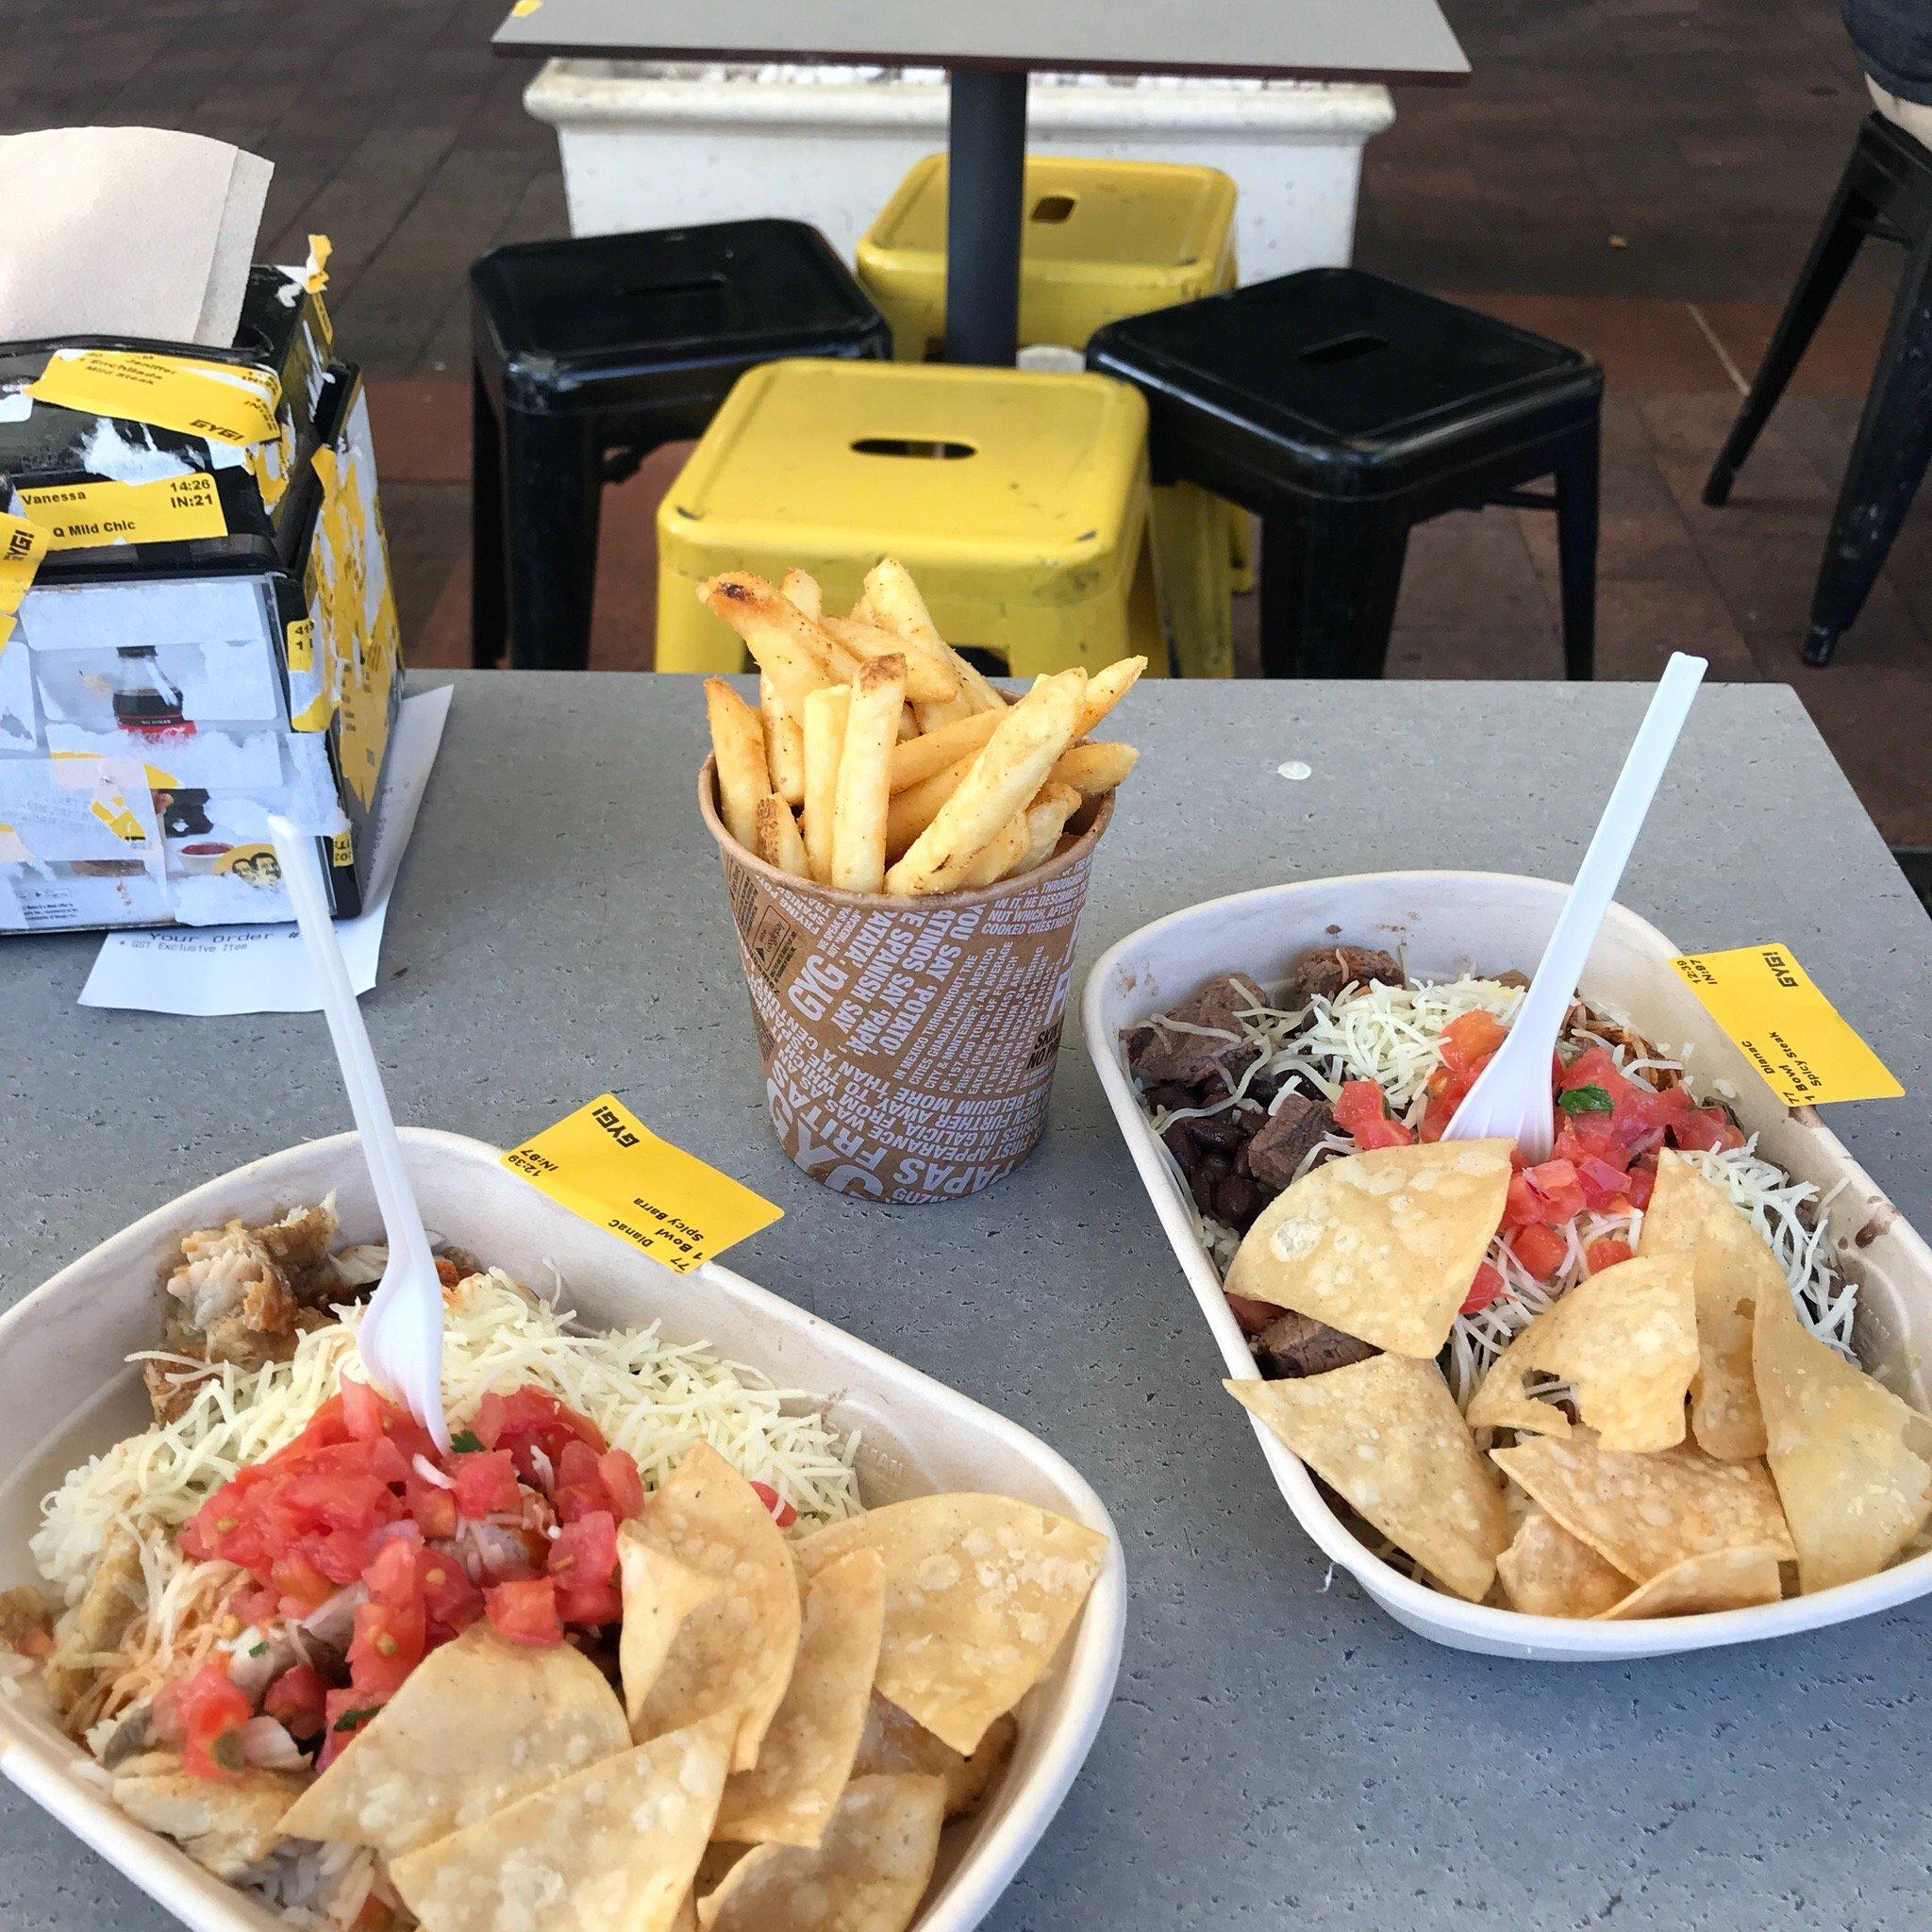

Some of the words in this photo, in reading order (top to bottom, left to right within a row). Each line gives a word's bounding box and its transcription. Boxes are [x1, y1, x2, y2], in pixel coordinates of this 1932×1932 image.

[190, 419, 245, 441] GYG!
[22, 490, 86, 506] Vanessa
[170, 479, 210, 493] 14:26
[171, 493, 213, 509] IN:21
[53, 528, 65, 539] Q
[995, 898, 1009, 908] IN
[1023, 896, 1038, 908] HE
[779, 897, 820, 935] FRYING
[949, 903, 987, 941] YOU
[988, 909, 1014, 922] NUT
[150, 932, 200, 943] Your
[824, 917, 844, 941] SPEAK
[902, 909, 957, 973] ATINOS
[981, 923, 1026, 936] COOKED
[158, 942, 217, 953] Exclusive
[851, 928, 914, 1003] SPANISH
[925, 944, 961, 982] SAY
[1676, 960, 1702, 984] 12:39
[1762, 951, 1798, 988] GYG!
[789, 954, 849, 1022] GYG
[879, 973, 914, 1008] SAY
[831, 1000, 863, 1034] SAY
[892, 1069, 907, 1080] IN
[900, 1037, 929, 1069] MEXICO
[923, 975, 965, 1035] THROUGHOUT
[959, 955, 978, 974] THE
[909, 1058, 933, 1085] CITIES
[969, 947, 996, 987] MEXICO
[924, 1070, 942, 1089] CITY
[938, 1060, 948, 1070] &
[976, 989, 990, 1002] AN
[985, 941, 1013, 986] AVERAGE
[939, 1081, 953, 1091] OF
[970, 1014, 991, 1042] TONS
[985, 999, 996, 1011] OF
[993, 956, 1019, 995] FRENCH
[968, 1065, 990, 1094] EATEN
[985, 1044, 1000, 1063] PER
[1016, 944, 1045, 999] SPENDING
[983, 1083, 994, 1094] 41
[991, 1042, 1013, 1080] BILLION
[1008, 992, 1034, 1039] MEXICAN
[1030, 956, 1049, 990] PESOS
[1021, 1008, 1039, 1042] PAPAS
[1034, 1015, 1042, 1028] OF
[954, 1067, 975, 1093] FRIES
[971, 1031, 995, 1065] (PAPAS
[990, 991, 1016, 1028] FRITAS)
[1010, 966, 1024, 988] ARE
[1026, 1030, 1038, 1048] LOT
[823, 1048, 838, 1063] A
[1012, 1042, 1023, 1056] ON
[1023, 1049, 1030, 1058] A
[1769, 1031, 1798, 1058] Steak
[784, 1044, 836, 1097] WHICH
[811, 1054, 841, 1085] THE
[838, 1061, 891, 1094] THAN
[999, 1058, 1017, 1084] YEAR
[1778, 1064, 1809, 1092] Bowl
[1794, 1058, 1822, 1087] Spicy
[800, 1076, 824, 1098] AS
[845, 1083, 869, 1102] TO
[894, 1087, 954, 1113] MORE
[995, 1085, 1005, 1094] A
[1783, 1091, 1800, 1105] 77
[772, 1059, 888, 1171] FRITAS
[824, 1099, 865, 1132] WAS
[840, 1093, 896, 1129] FROM
[956, 1092, 1026, 1115] BELGIUM
[591, 1106, 641, 1149] GYG!
[935, 1113, 1011, 1130] FURTHER
[868, 1125, 991, 1161] APPEARANCE
[981, 1131, 999, 1146] IN
[508, 1155, 541, 1177] 12:39
[633, 1197, 669, 1222] Barra
[654, 1227, 694, 1254] Bowl
[667, 1218, 704, 1242] Spicy
[670, 1257, 690, 1272] 77
